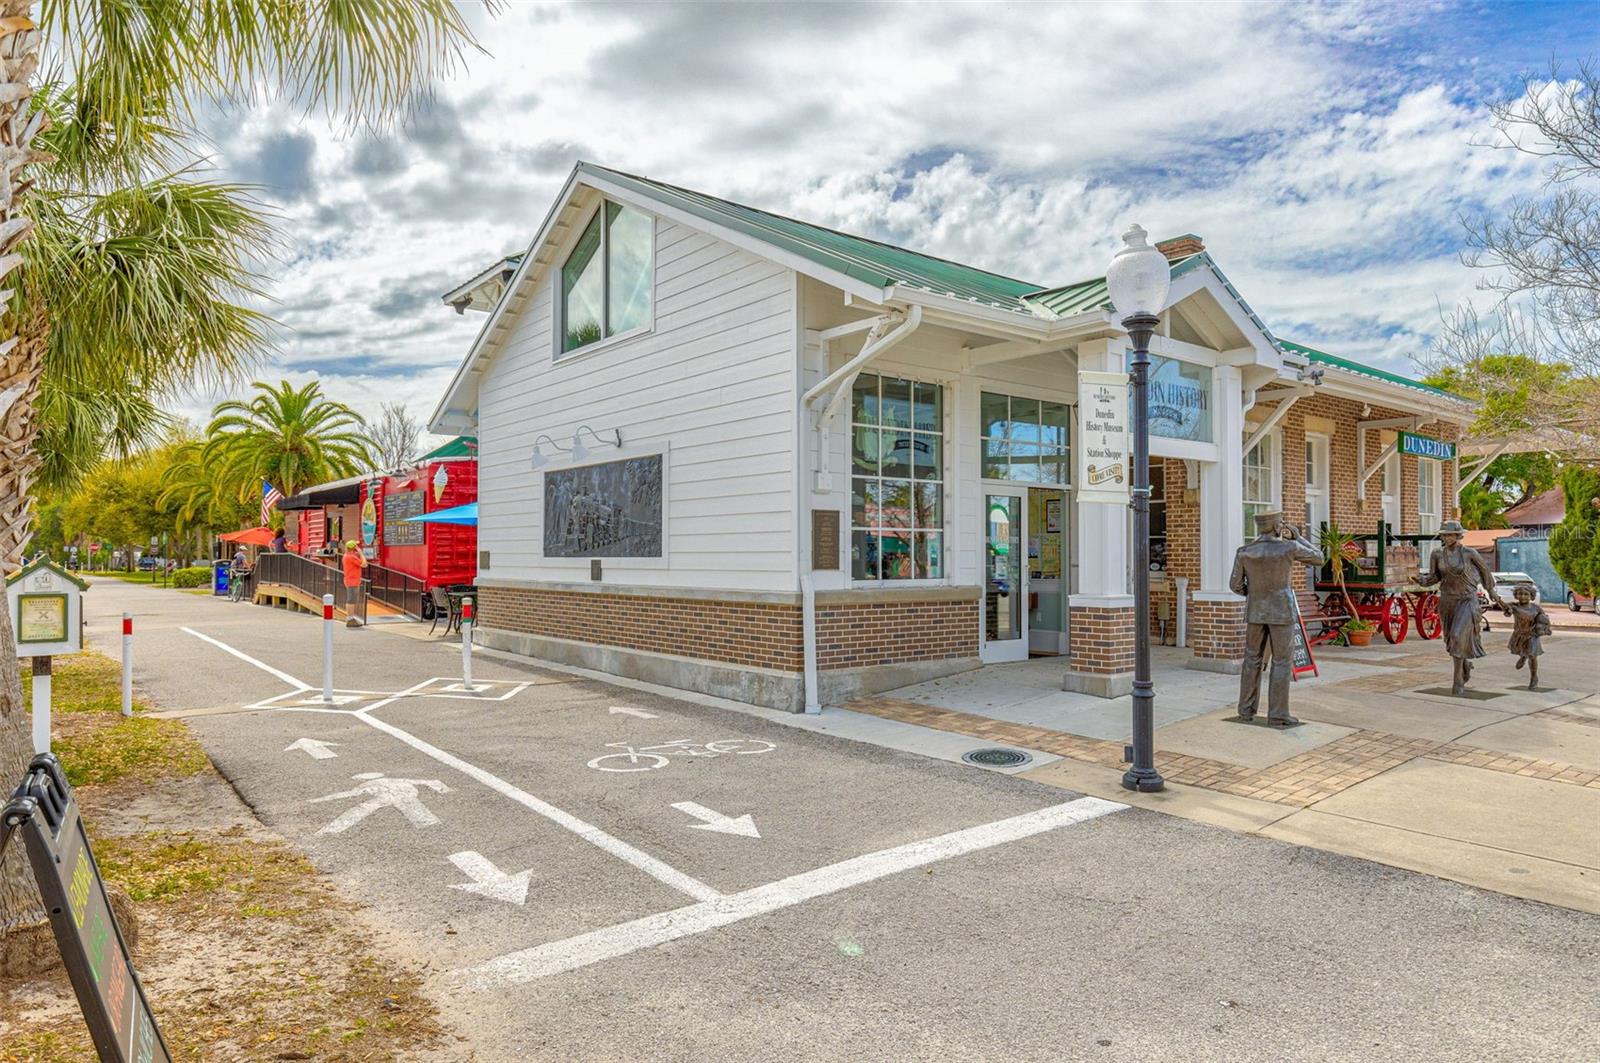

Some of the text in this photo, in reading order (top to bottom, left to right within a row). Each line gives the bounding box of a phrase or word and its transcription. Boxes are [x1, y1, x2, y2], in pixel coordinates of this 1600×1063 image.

[1168, 383, 1209, 410] HISTORY
[1095, 407, 1115, 419] Dunedin
[1086, 420, 1123, 433] History Museum
[1403, 435, 1452, 457] DUNEDIN
[1087, 448, 1122, 460] Station Shoppe
